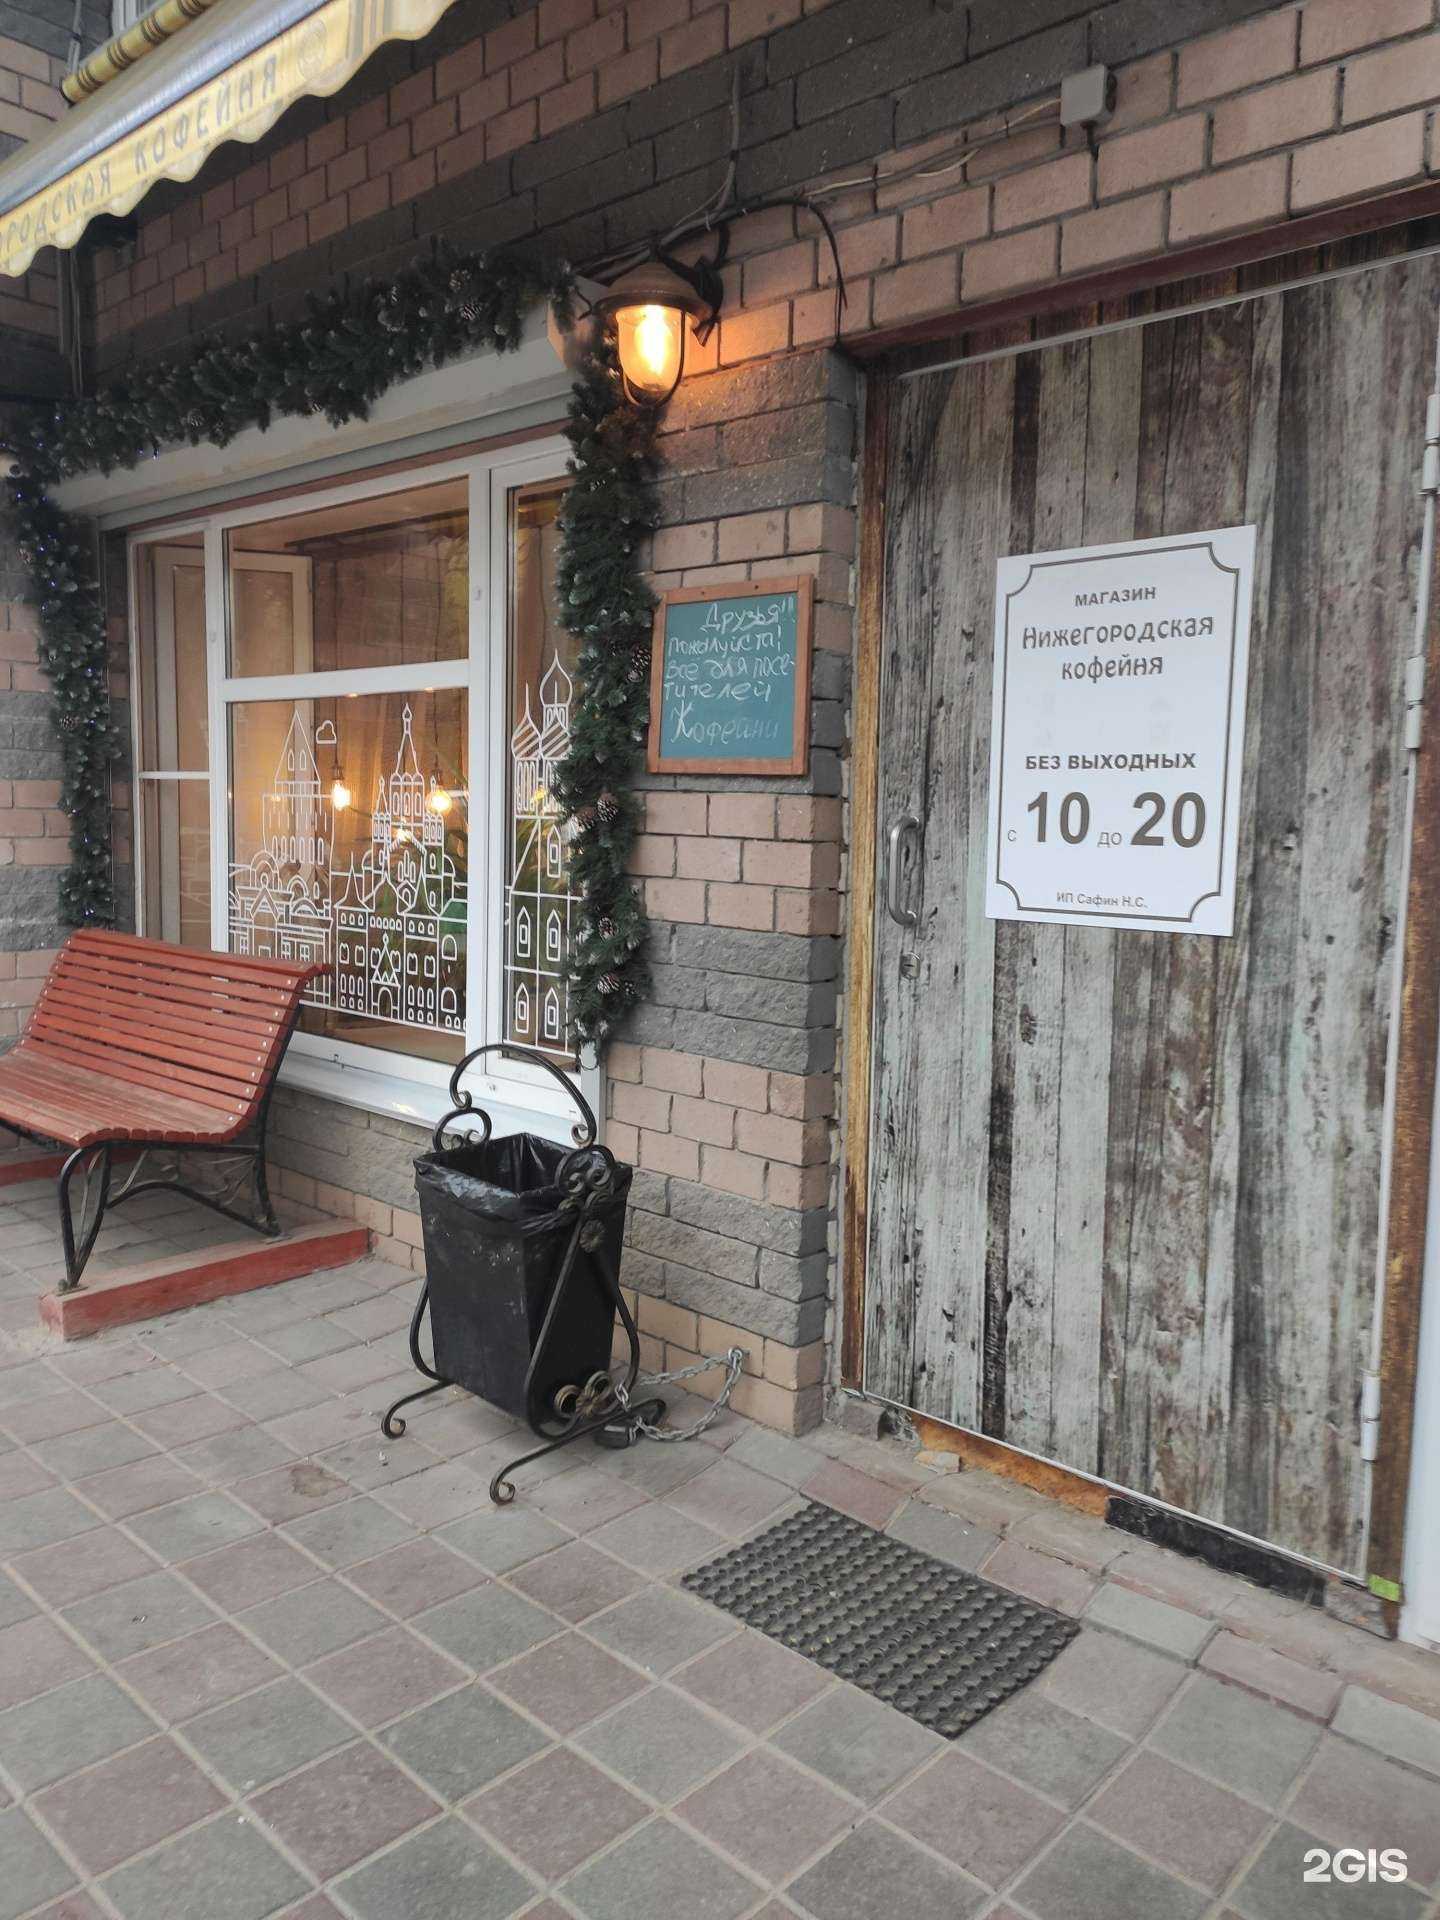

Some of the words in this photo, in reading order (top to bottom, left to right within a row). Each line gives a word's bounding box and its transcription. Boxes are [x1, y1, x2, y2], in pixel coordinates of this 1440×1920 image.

[134, 53, 277, 174] КОФЕЙНЯ
[1074, 586, 1157, 607] МАГАЗИН
[1022, 616, 1214, 650] Нижегородская
[1061, 654, 1164, 684] кофейня
[1025, 755, 1061, 770] БЕЗ
[1067, 753, 1197, 772] ВЫХОДНЫХ
[1027, 791, 1090, 845] 10
[1130, 792, 1206, 848] 20
[1056, 891, 1073, 904] ИП
[1077, 892, 1119, 908] Сафин
[1122, 895, 1148, 909] Н.С.
